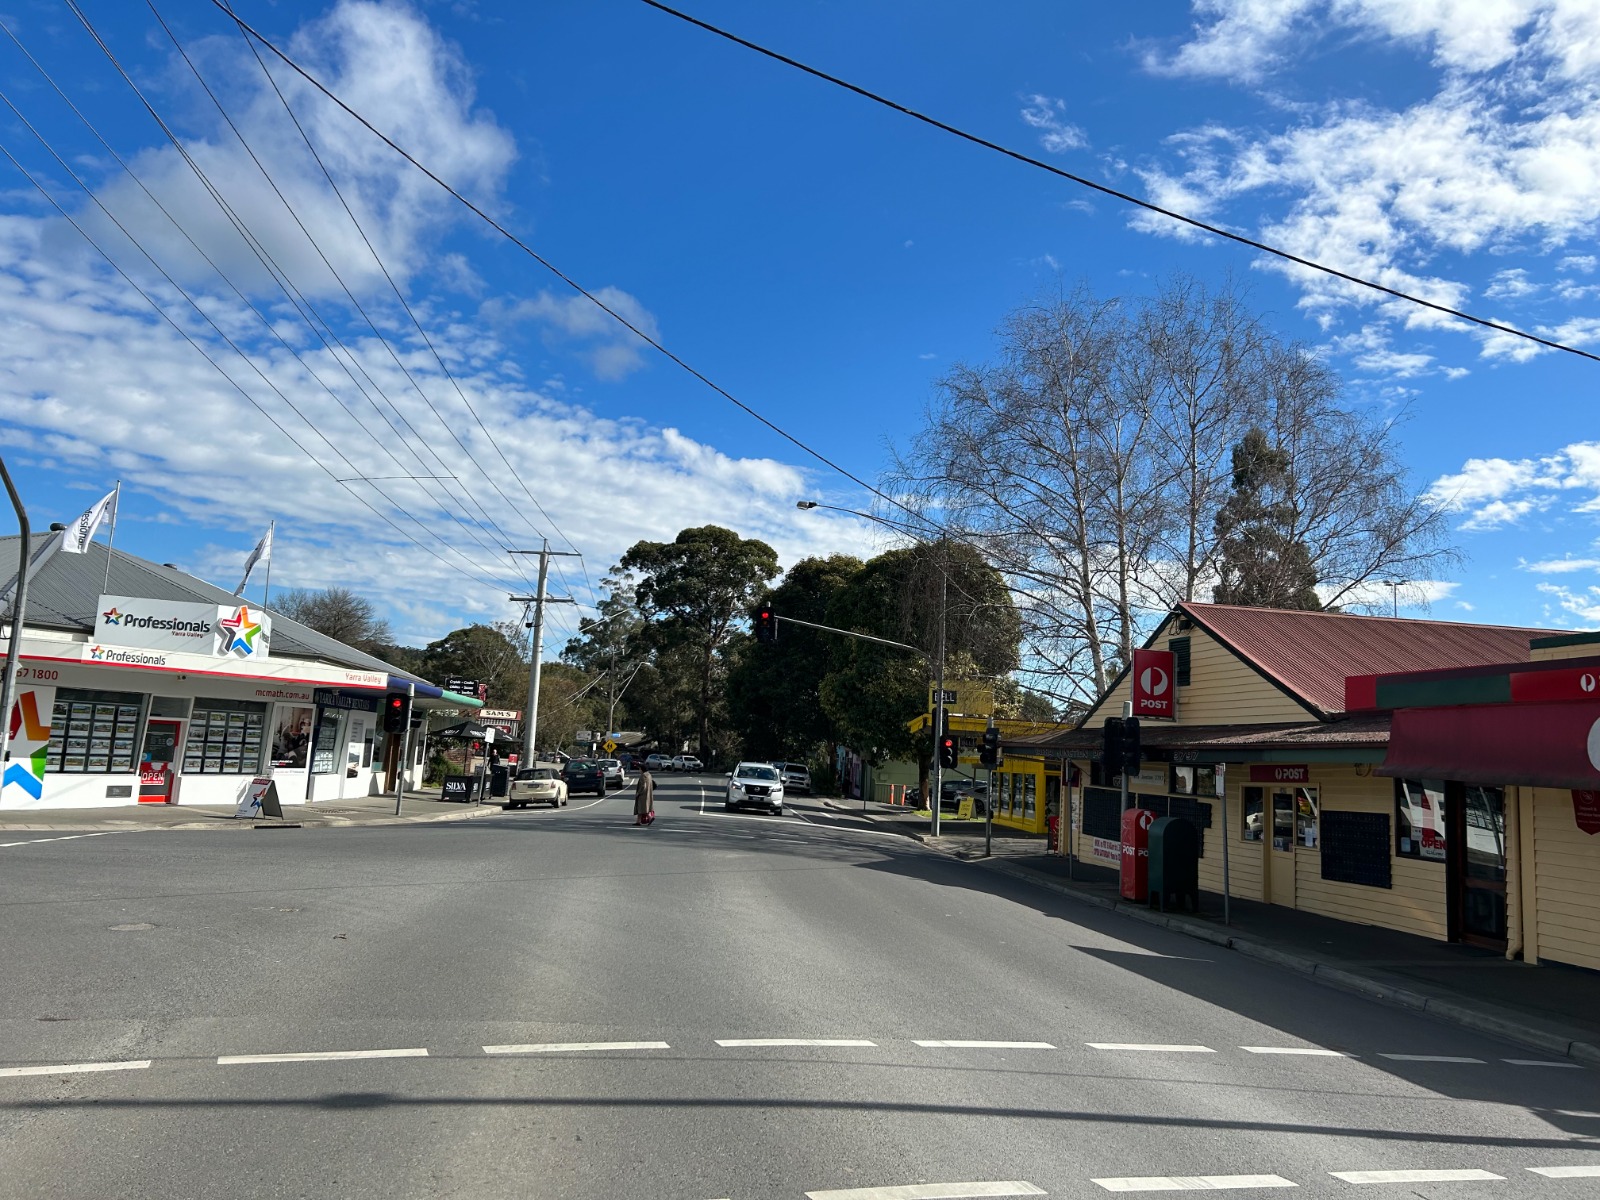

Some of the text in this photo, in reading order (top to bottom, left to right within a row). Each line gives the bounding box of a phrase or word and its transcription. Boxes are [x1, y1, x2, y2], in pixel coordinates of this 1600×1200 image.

[125, 614, 210, 633] Professionals
[106, 650, 166, 665] Professionals
[33, 669, 59, 680] 1800
[345, 673, 381, 684] Yarra Valley
[256, 689, 309, 699] mcmath.com.au
[1141, 699, 1168, 709] POST
[142, 772, 164, 781] OPEN
[1283, 768, 1304, 780] POST
[445, 782, 466, 791] SILVA
[1422, 839, 1446, 850] OPEN
[1123, 845, 1135, 856] POST
[1138, 849, 1148, 857] PO
